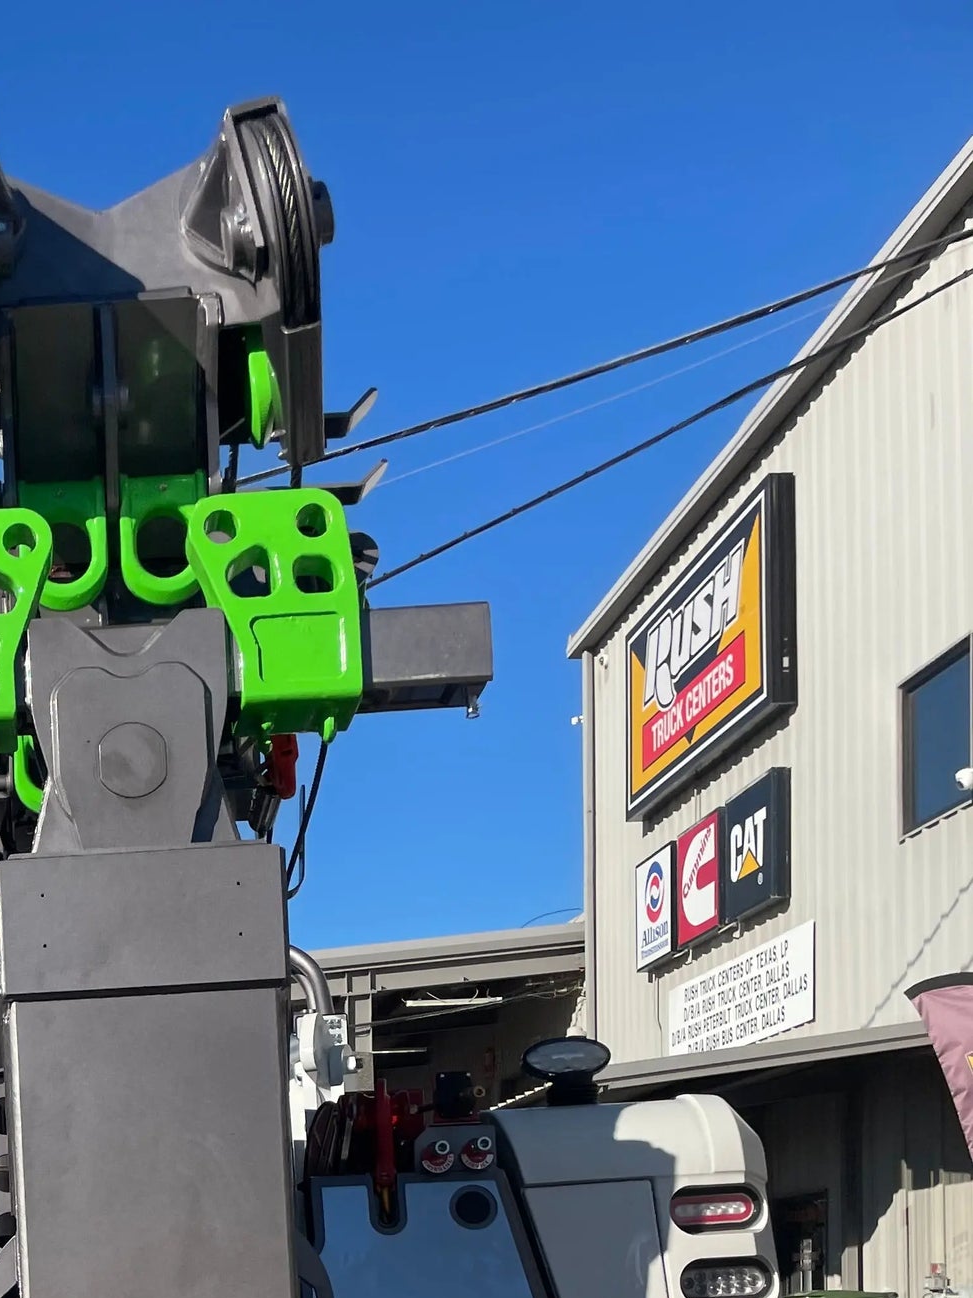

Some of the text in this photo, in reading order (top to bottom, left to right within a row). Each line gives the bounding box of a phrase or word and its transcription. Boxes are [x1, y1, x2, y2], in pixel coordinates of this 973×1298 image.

[643, 538, 745, 711] RUSH
[651, 653, 734, 752] TRUCK CENTERS
[682, 827, 713, 899] Cummins
[730, 806, 767, 883] CAT
[641, 920, 669, 949] Allison
[683, 997, 701, 1022] D/B/A
[702, 994, 716, 1014] RUSH
[717, 988, 736, 1008] TRUCK
[765, 961, 790, 987] DALLAS
[684, 984, 699, 1003] RUSH
[700, 973, 716, 996] TRUCK
[717, 962, 744, 987] CENTERS
[745, 957, 754, 974] OF
[780, 939, 789, 959] LP
[671, 1026, 686, 1047] D/B/A
[687, 1021, 702, 1040] RUSH
[703, 1007, 731, 1034] PETERBILT
[734, 1000, 753, 1021] TRUCK
[783, 973, 808, 1000] DALLAS
[705, 1033, 720, 1051] RUSH
[721, 1027, 733, 1046] BUS
[761, 1005, 786, 1030] DALLAS
